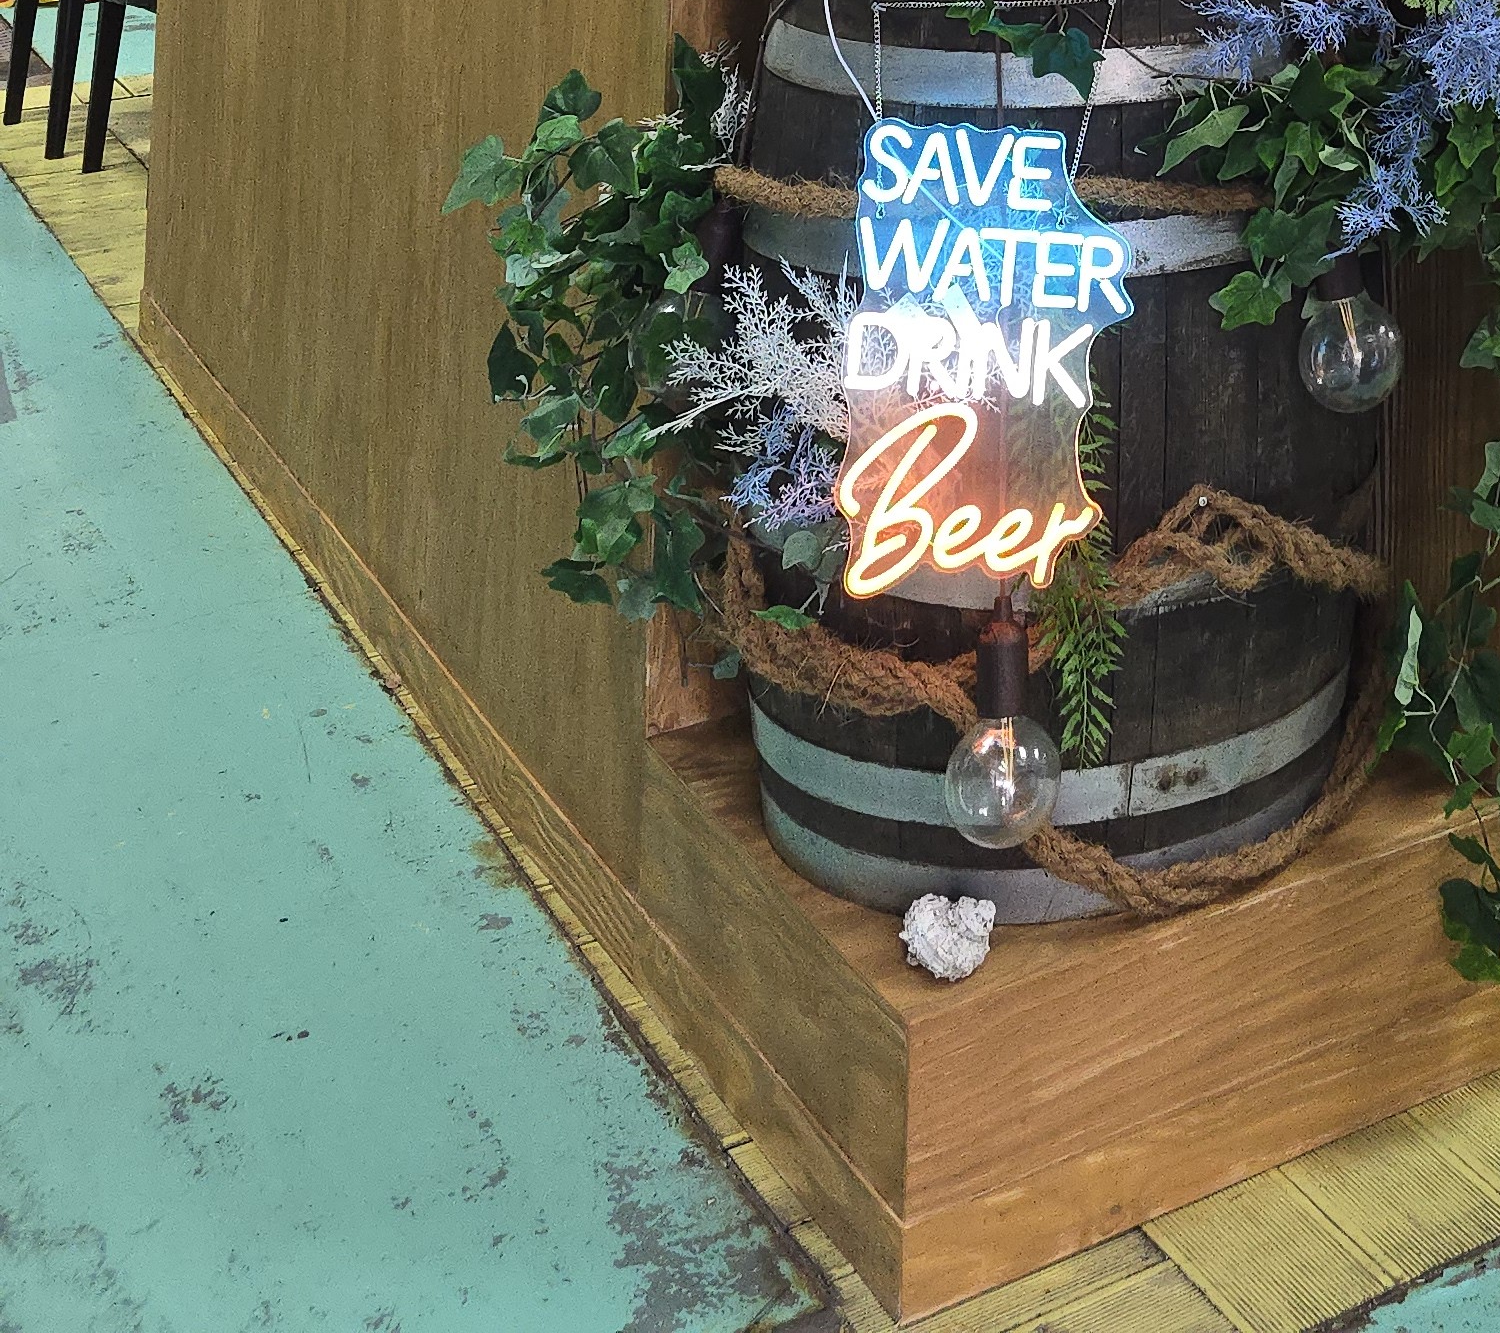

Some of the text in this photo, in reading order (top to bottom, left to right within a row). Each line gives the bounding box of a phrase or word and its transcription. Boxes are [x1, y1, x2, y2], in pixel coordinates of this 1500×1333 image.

[861, 125, 1062, 213] SAVE
[860, 214, 1128, 317] WATER
[844, 310, 1094, 410] DRINK
[841, 402, 1094, 599] Beer
